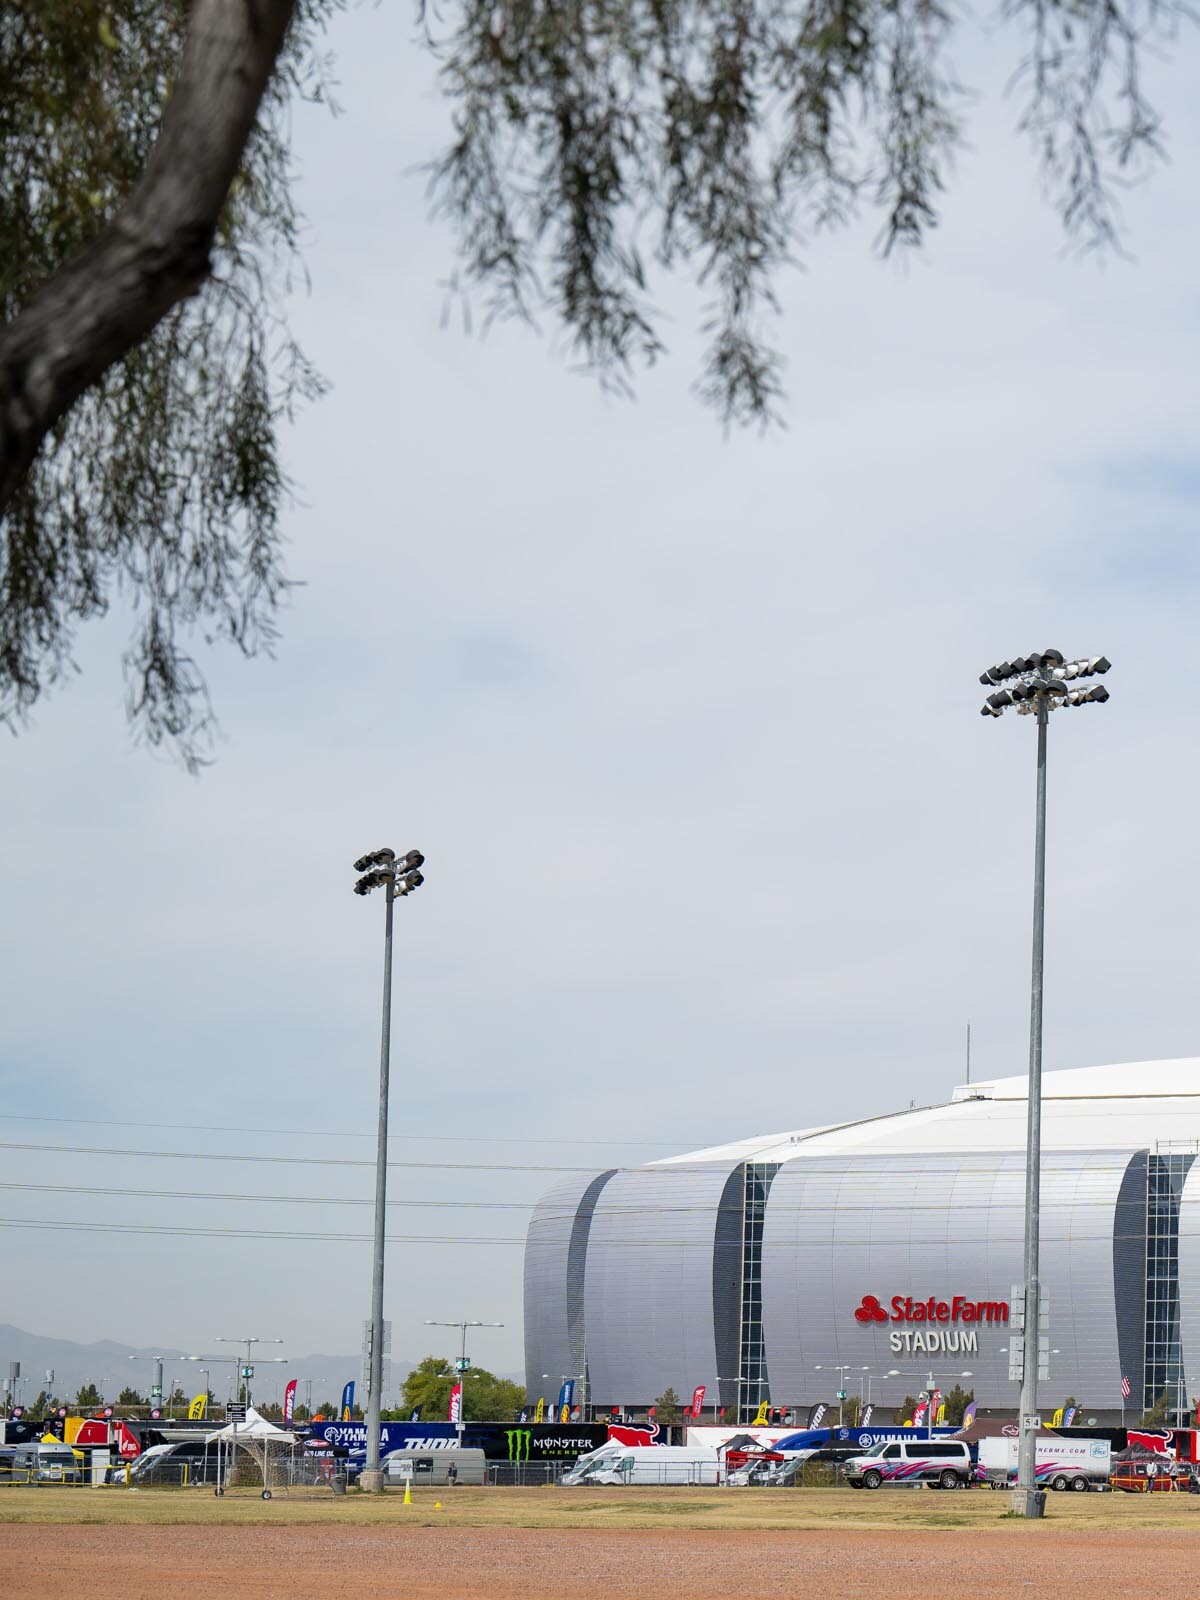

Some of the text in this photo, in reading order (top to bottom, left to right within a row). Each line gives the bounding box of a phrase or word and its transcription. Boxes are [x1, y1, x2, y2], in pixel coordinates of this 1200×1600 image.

[890, 1295, 1009, 1322] State Farm
[889, 1331, 978, 1352] STADIUM
[810, 1404, 826, 1430] HOR
[339, 1428, 389, 1441] YAMA
[533, 1437, 594, 1449] MONSTER
